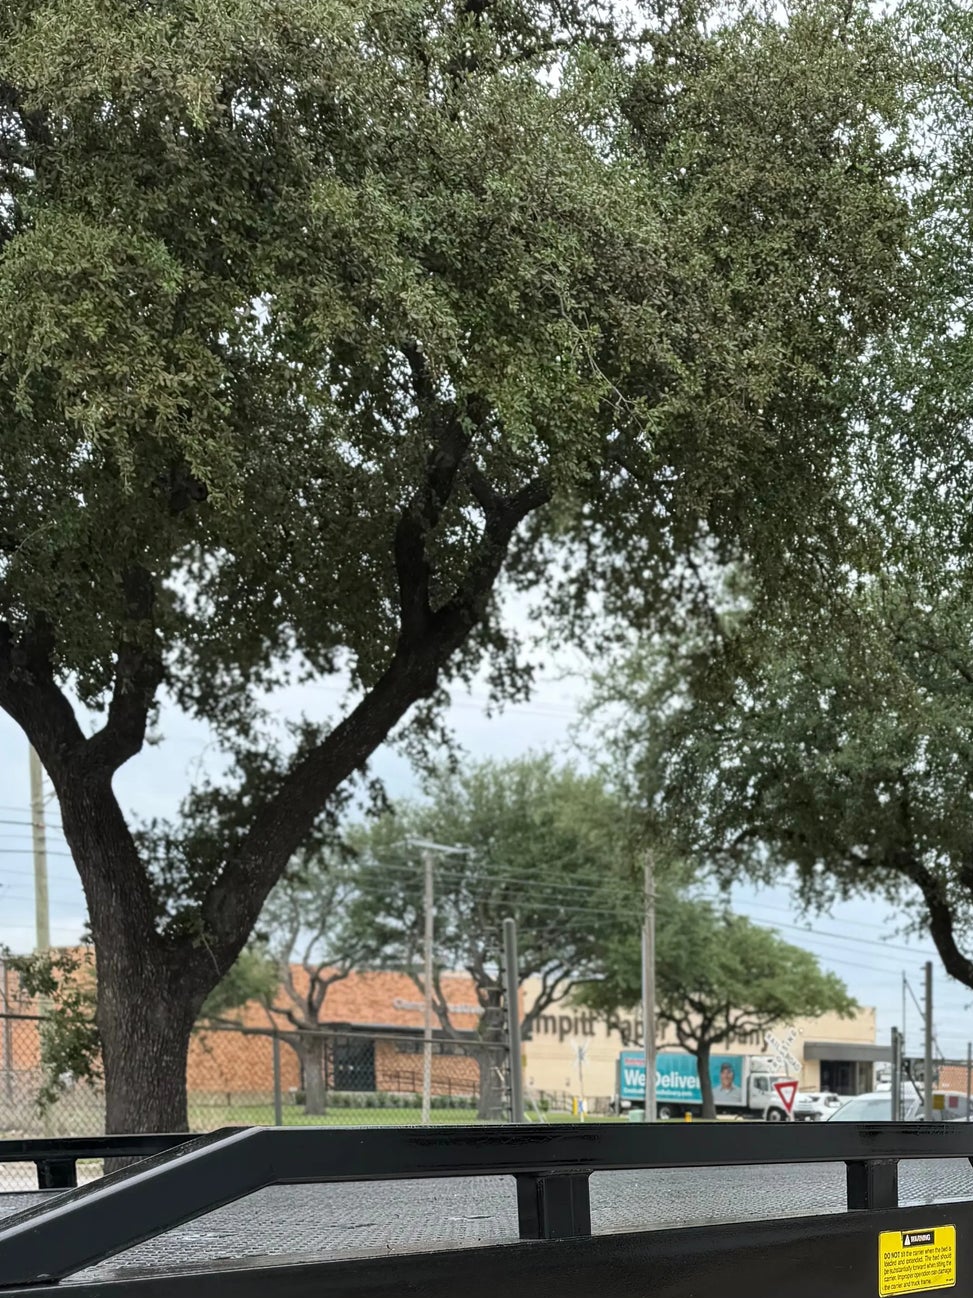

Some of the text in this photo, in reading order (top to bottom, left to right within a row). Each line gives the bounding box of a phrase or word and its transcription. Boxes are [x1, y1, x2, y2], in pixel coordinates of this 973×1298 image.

[528, 1010, 596, 1043] mpitt
[605, 1012, 670, 1046] Papr
[624, 1069, 646, 1087] We
[910, 1234, 930, 1243] WARNING
[891, 1251, 900, 1259] NOT
